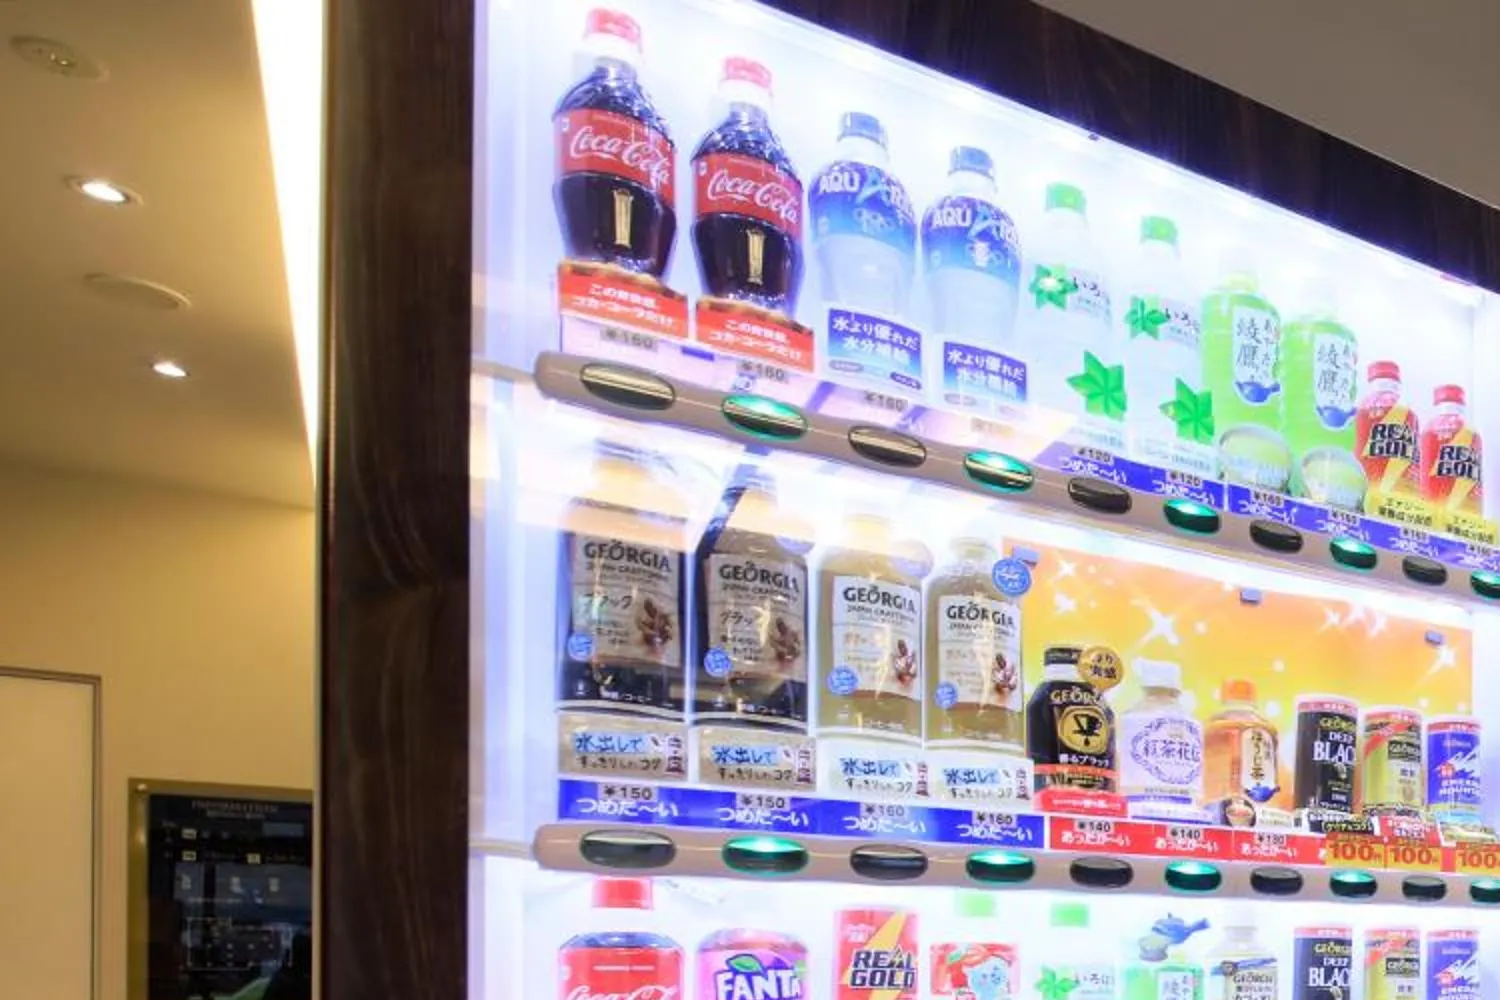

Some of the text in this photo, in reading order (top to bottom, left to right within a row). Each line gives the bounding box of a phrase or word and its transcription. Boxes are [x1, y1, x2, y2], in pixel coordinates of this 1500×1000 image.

[570, 124, 672, 192] Coca-Cola
[707, 168, 798, 222] Coca-Cola
[1314, 741, 1357, 764] BLAC
[1309, 968, 1351, 988] BLAC
